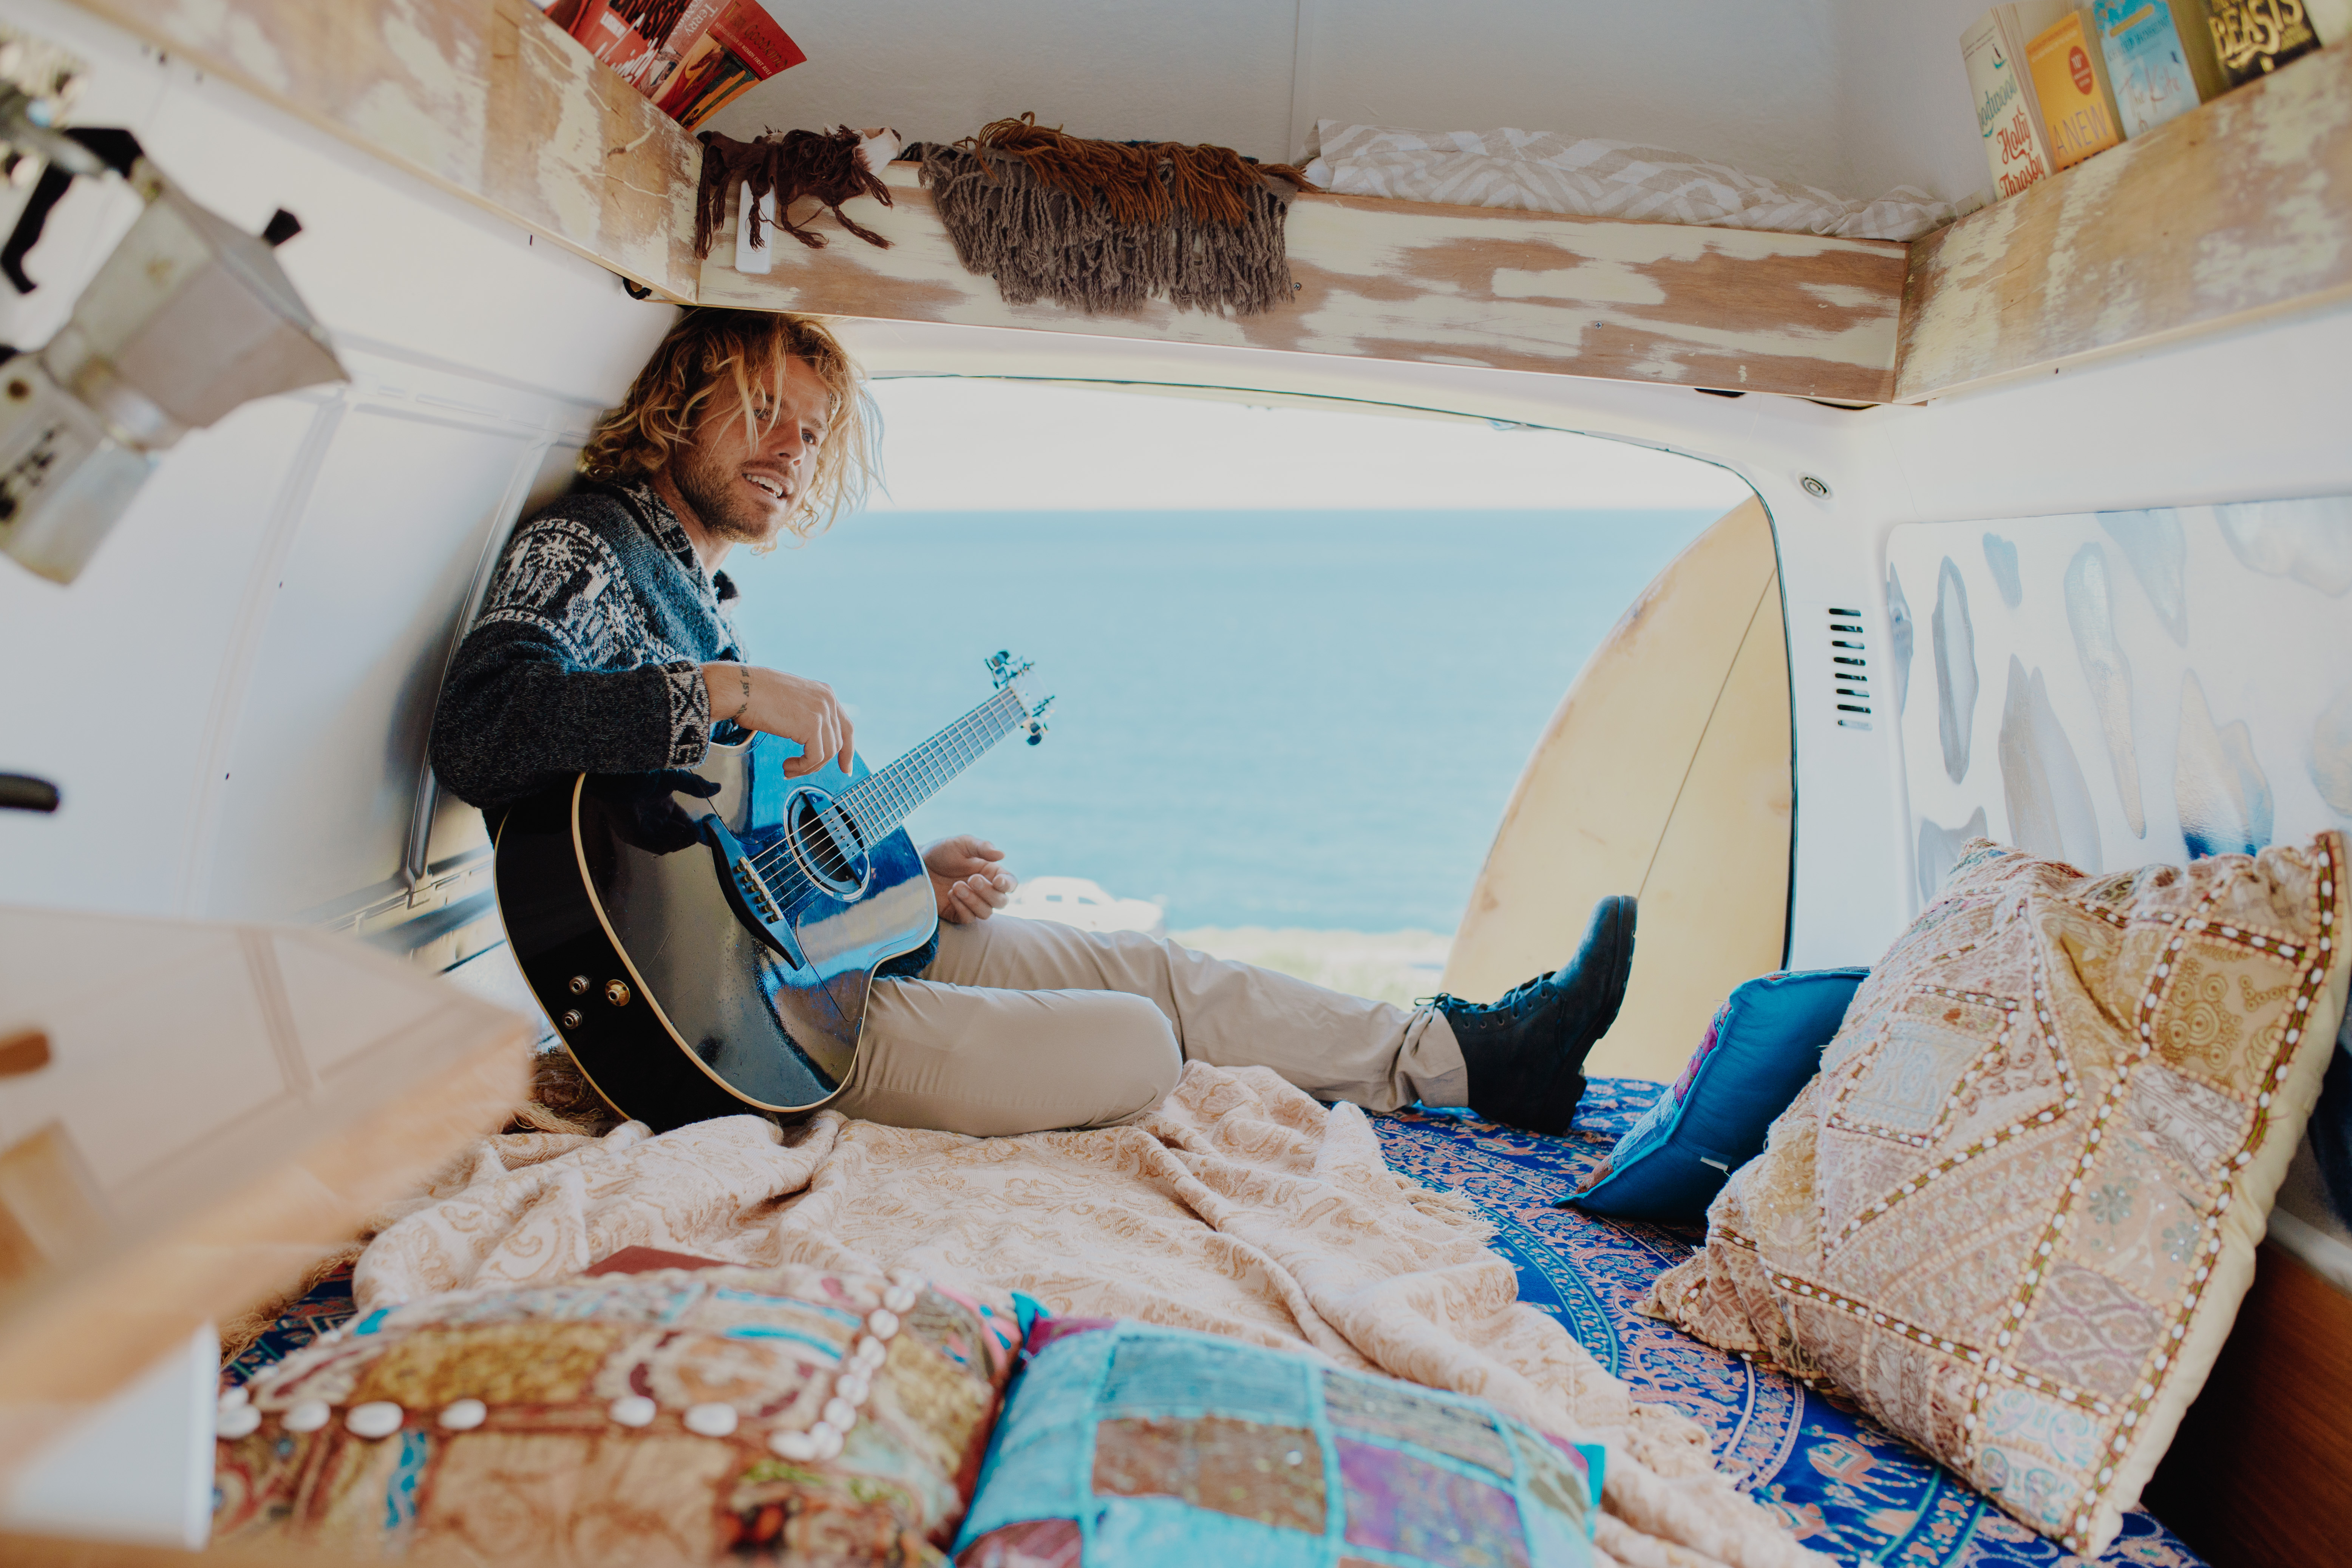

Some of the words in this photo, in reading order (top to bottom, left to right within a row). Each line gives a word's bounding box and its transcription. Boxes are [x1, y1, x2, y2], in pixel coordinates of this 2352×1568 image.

[741, 45, 755, 58] WIZARDS
[753, 57, 763, 66] FIRST
[762, 65, 772, 76] RULE
[1997, 105, 2033, 165] Holly
[2062, 102, 2108, 151] NEW
[2000, 153, 2046, 199] Throsby
